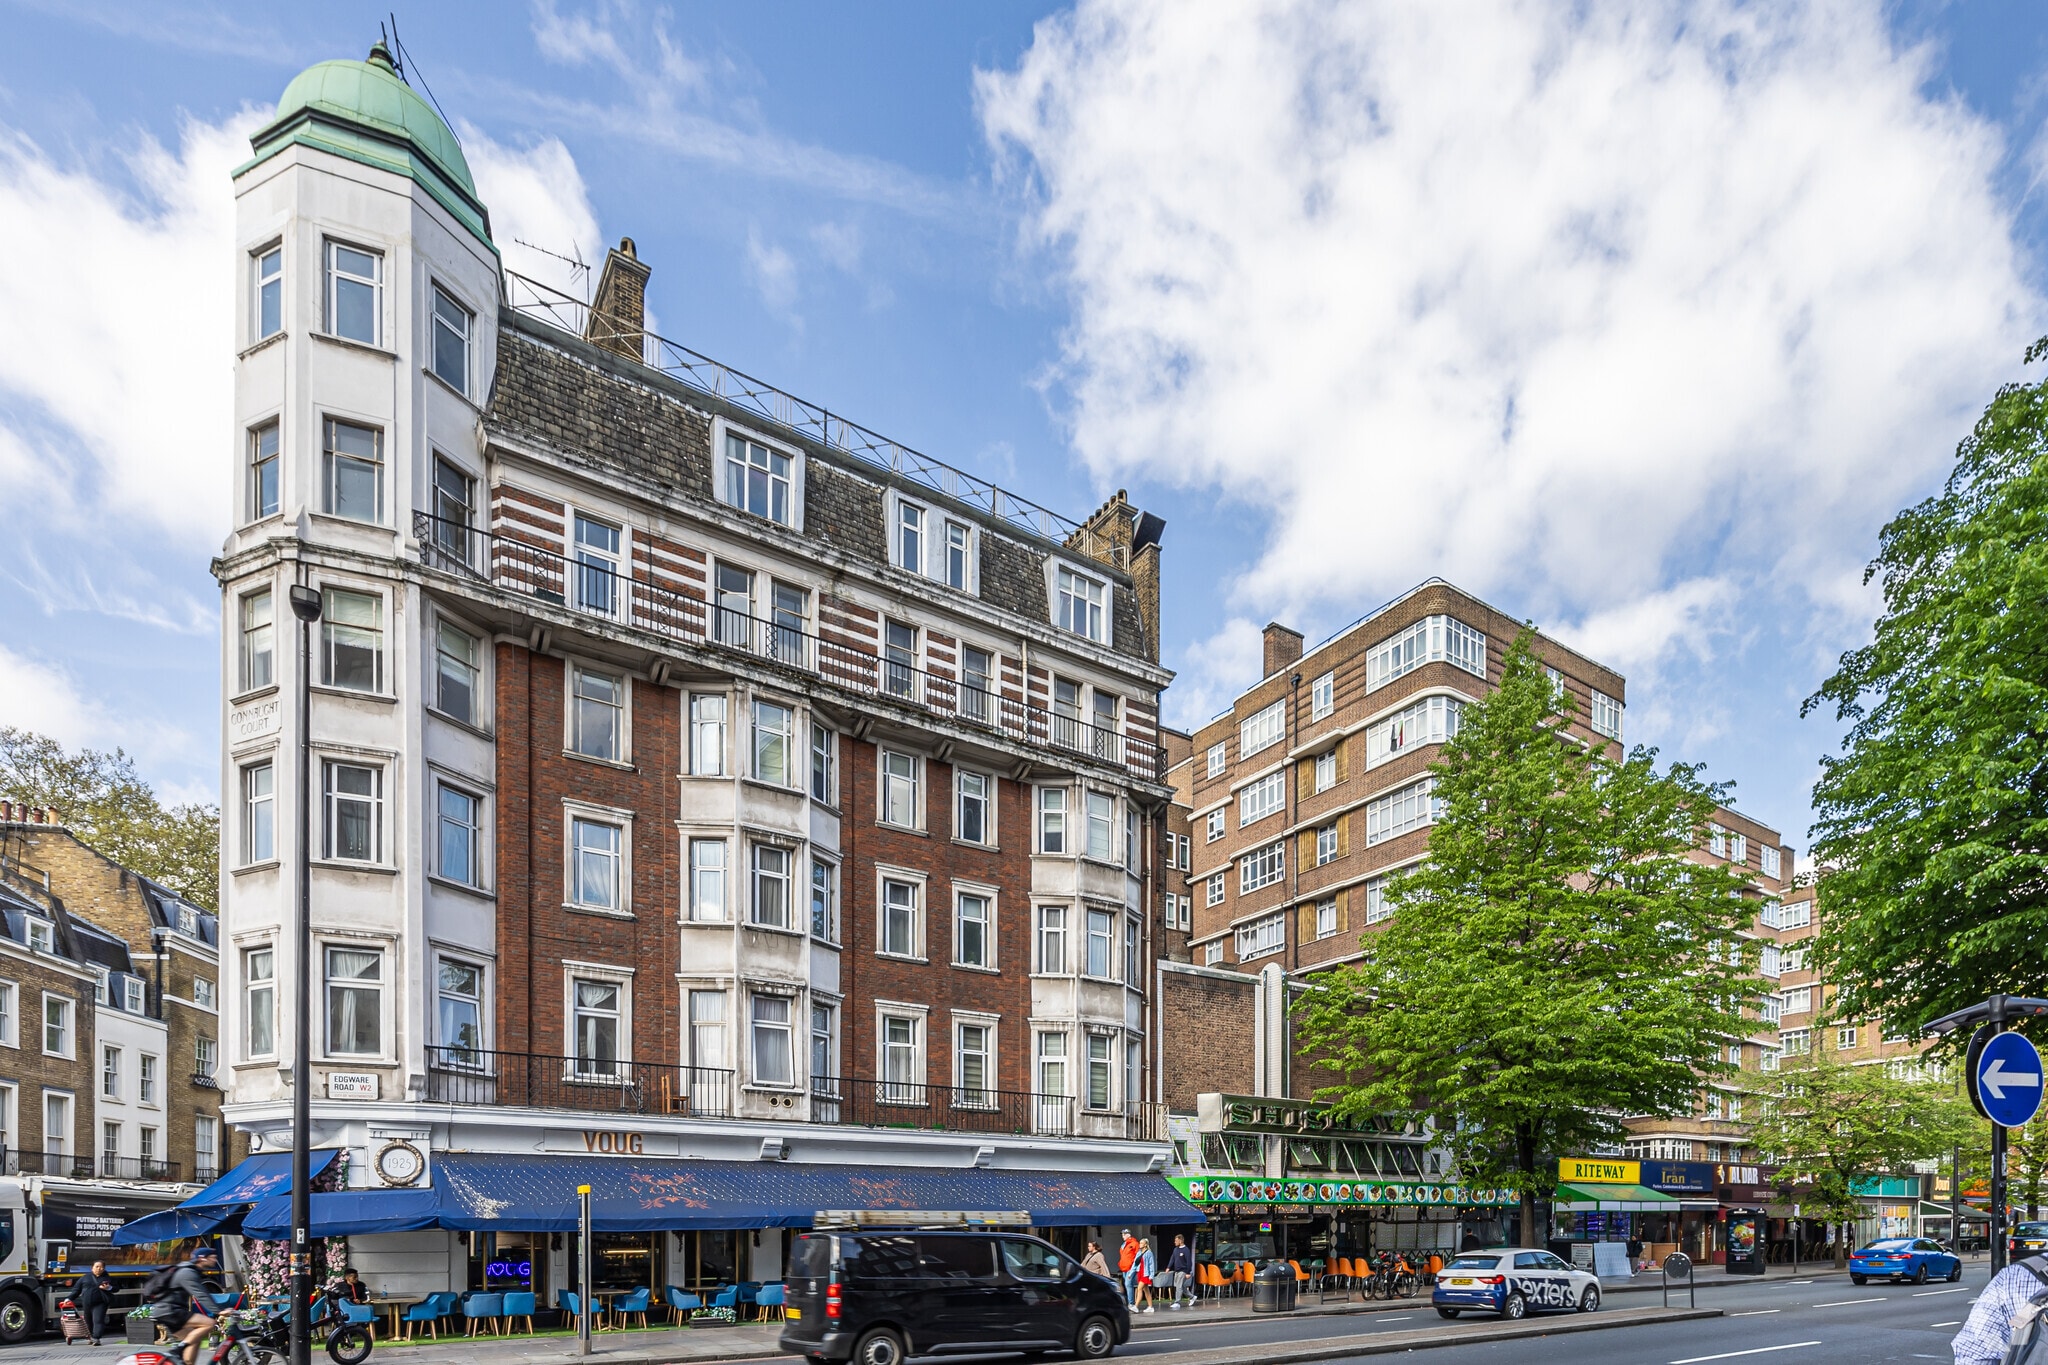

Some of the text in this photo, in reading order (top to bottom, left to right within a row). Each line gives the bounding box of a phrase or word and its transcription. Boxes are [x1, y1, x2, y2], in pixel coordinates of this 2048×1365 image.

[231, 701, 279, 725] CONNAUGHT
[241, 717, 269, 735] COURT
[334, 1075, 370, 1084] EDGWARE
[334, 1083, 355, 1091] ROAD
[582, 1131, 642, 1155] VOUG
[388, 1157, 412, 1170] 1925
[1575, 1163, 1626, 1179] RITEWAY
[1661, 1170, 1685, 1184] Iran
[1729, 1166, 1741, 1184] AL
[1741, 1166, 1759, 1185] DAR
[629, 1186, 708, 1196] VOUG
